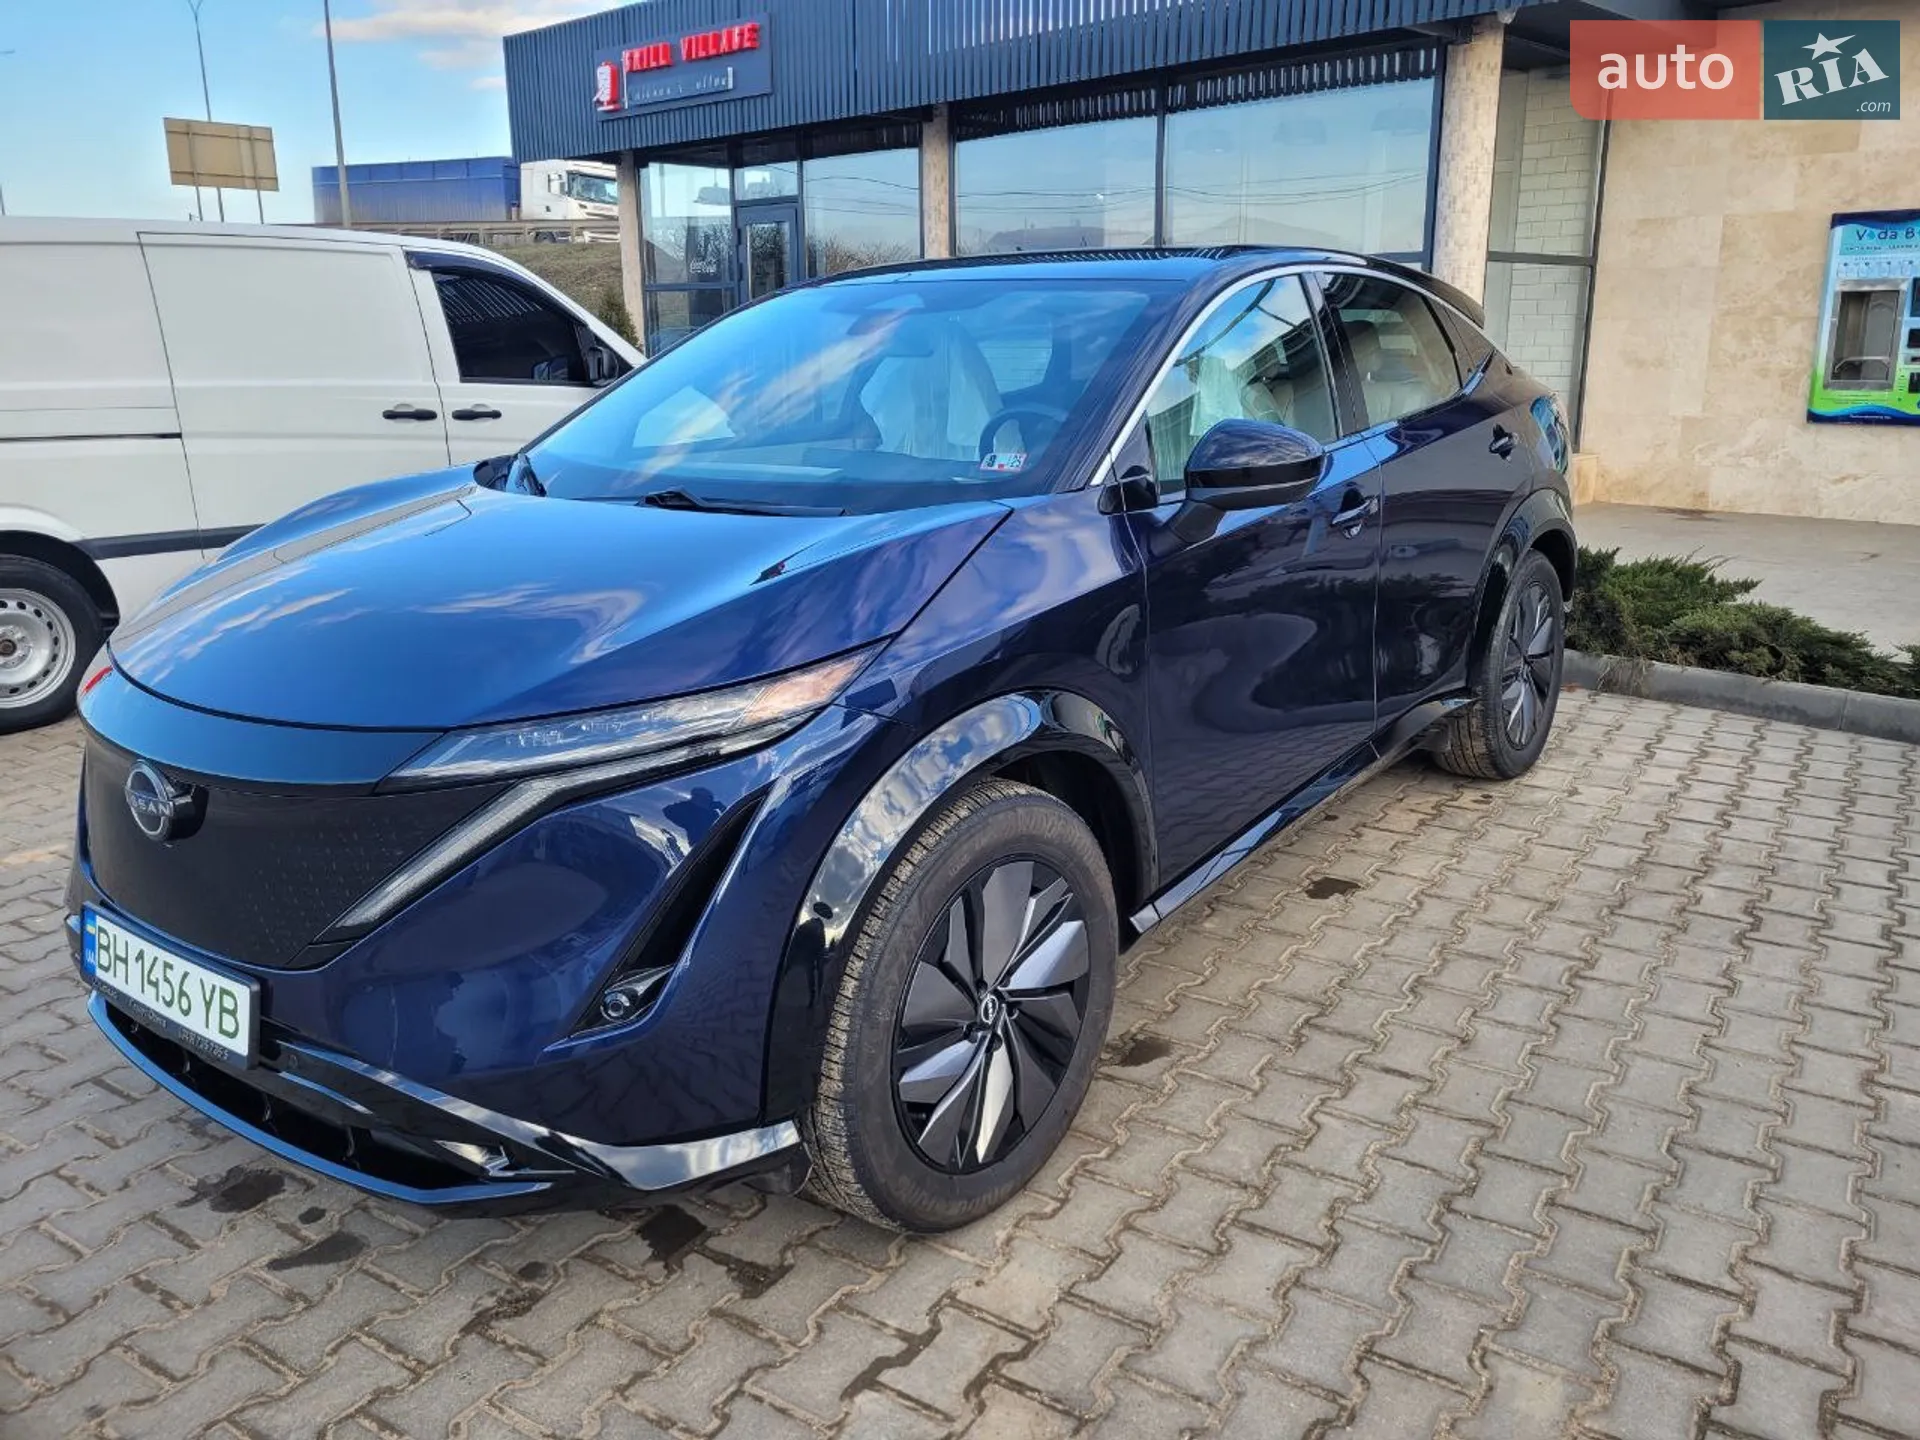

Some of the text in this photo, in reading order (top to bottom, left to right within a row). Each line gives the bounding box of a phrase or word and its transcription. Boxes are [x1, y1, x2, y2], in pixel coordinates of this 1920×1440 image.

[97, 925, 129, 985] BH
[135, 948, 192, 1017] 1456
[200, 977, 240, 1040] YB
